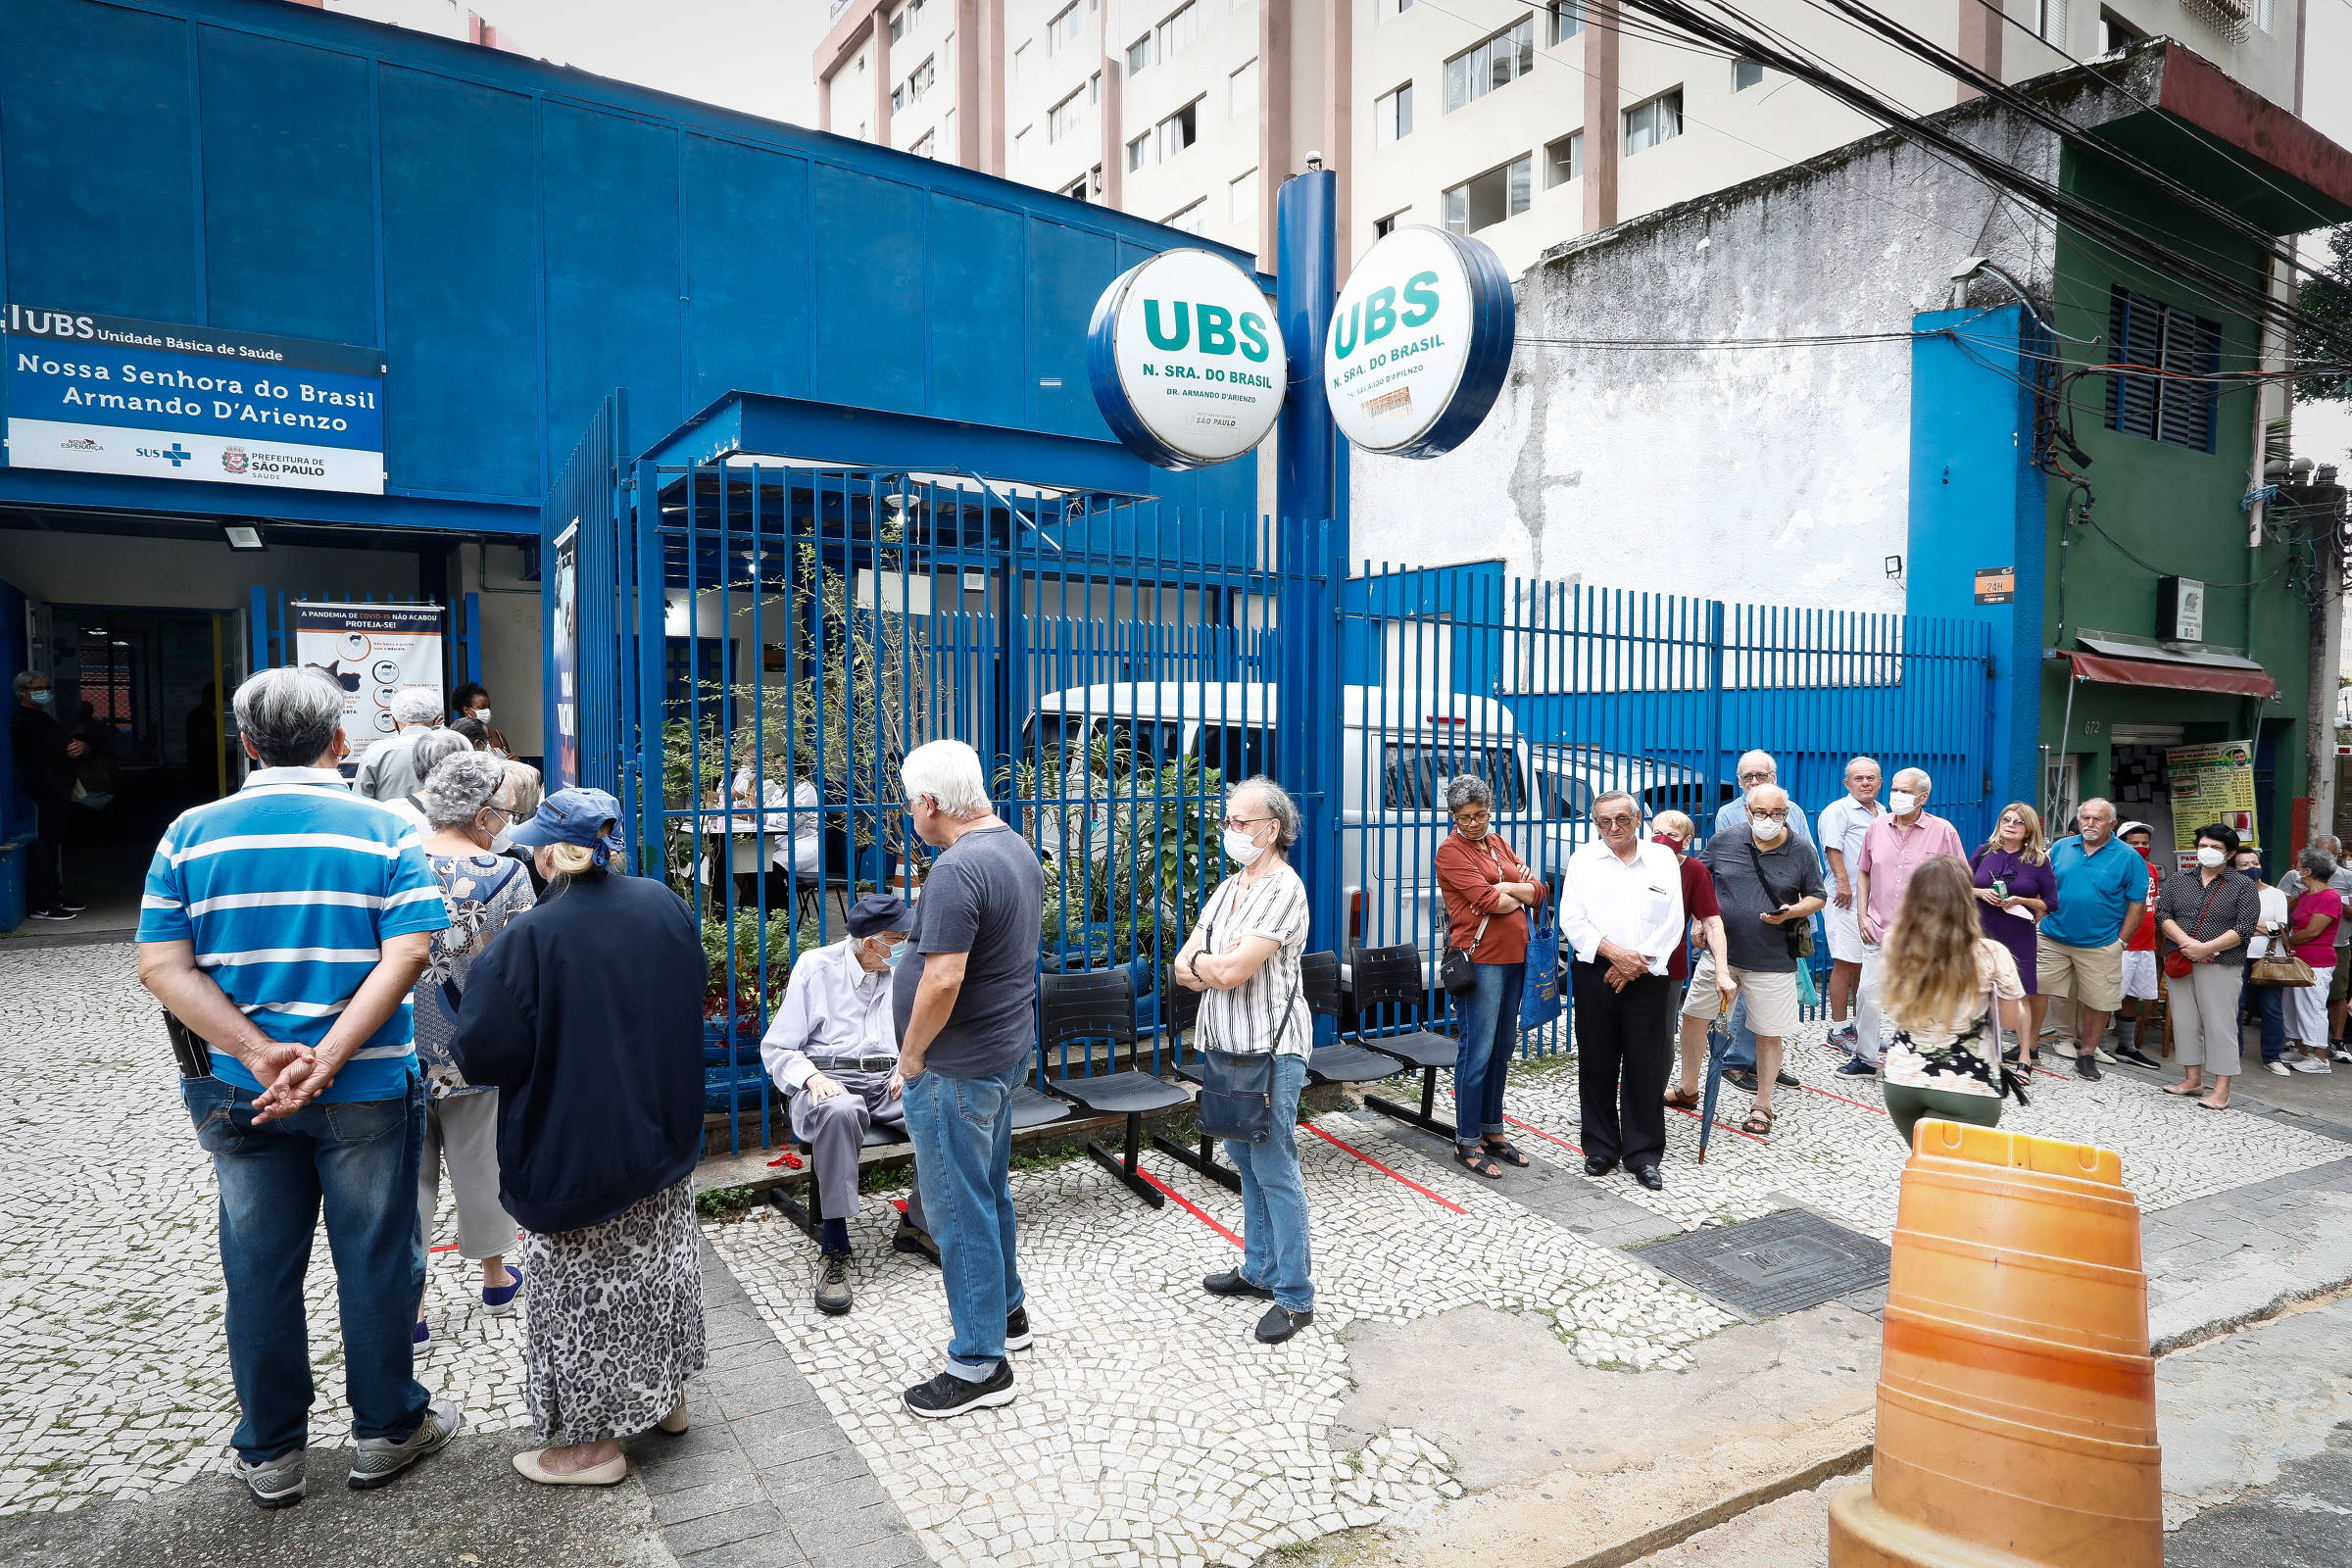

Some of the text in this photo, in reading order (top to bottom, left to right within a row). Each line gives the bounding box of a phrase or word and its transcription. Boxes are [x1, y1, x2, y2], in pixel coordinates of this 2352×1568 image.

[1334, 270, 1440, 361] UBS
[25, 310, 283, 361] UBS Unidade Básica de Saúde
[1144, 299, 1270, 364] UBS
[1334, 334, 1446, 389] N. SRA. DO BRASIL
[18, 354, 375, 410] Nossa Senhora do Brasil
[1143, 364, 1272, 390] N. SRA. DO BRASIL
[1182, 389, 1220, 399] ARMANDO
[1221, 393, 1256, 404] D'ARIENZO
[63, 386, 348, 432] Armando D'Arienzo
[1196, 416, 1211, 424] SÃO
[135, 448, 160, 458] SUS
[252, 452, 310, 465] PREFEITURA
[252, 461, 324, 476] SÃO PAULO
[1986, 582, 2003, 593] 24H
[309, 611, 347, 619] PANDEMIA
[345, 620, 397, 629] PROTEJA-SE!
[2085, 720, 2100, 736] 672
